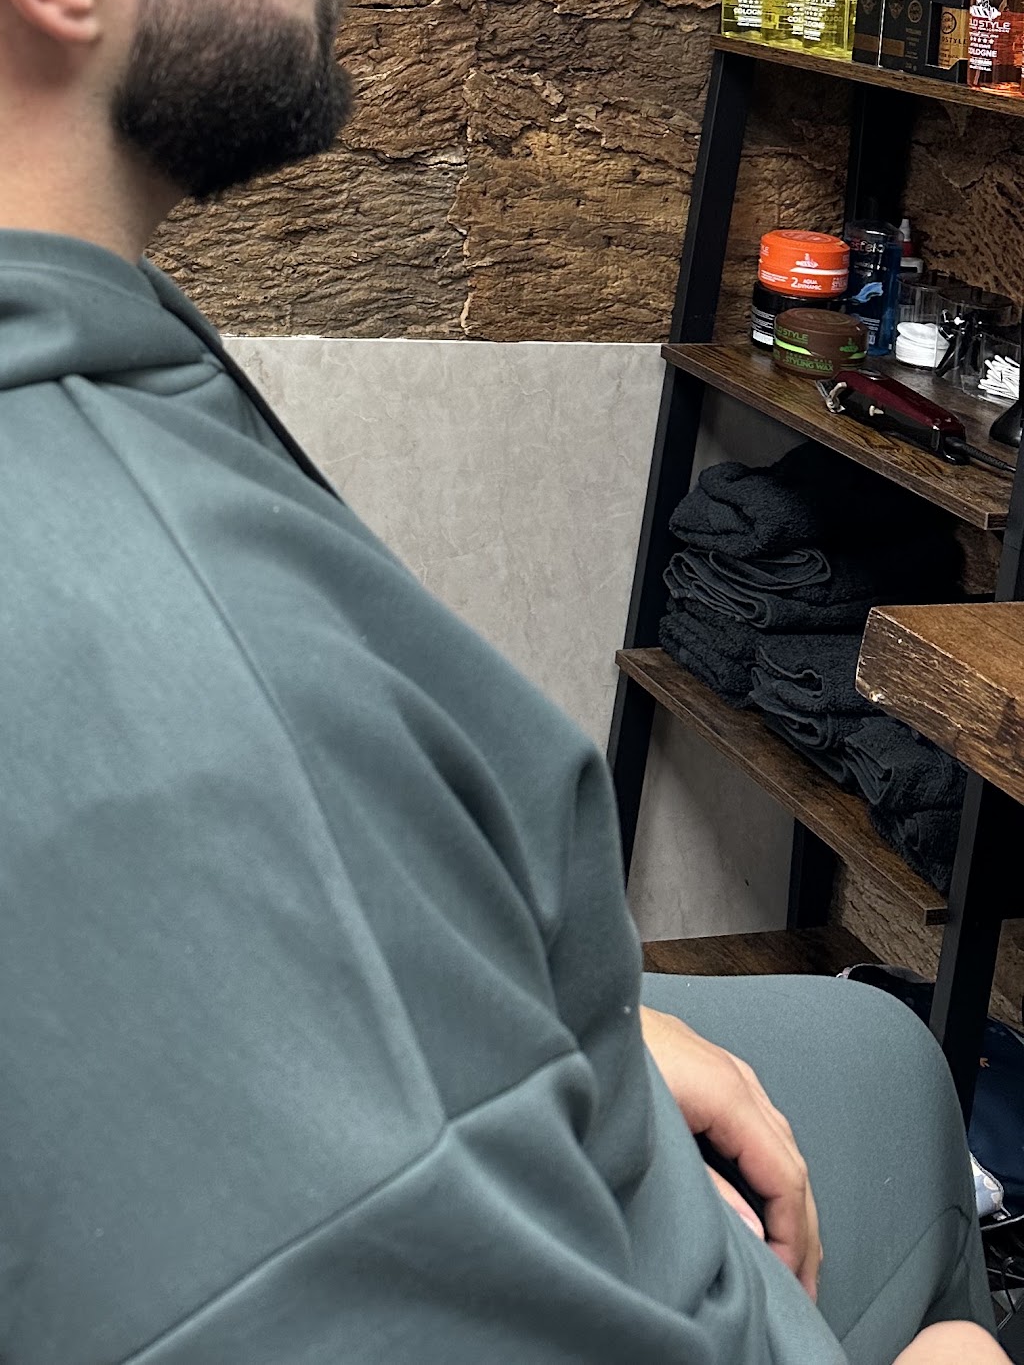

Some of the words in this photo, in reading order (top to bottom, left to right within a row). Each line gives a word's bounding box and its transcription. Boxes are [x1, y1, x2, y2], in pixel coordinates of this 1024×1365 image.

[979, 20, 1011, 29] STYLE
[791, 277, 798, 287] 2
[784, 329, 809, 340] STYLE
[785, 357, 814, 368] STYLING
[816, 363, 834, 372] WAX
